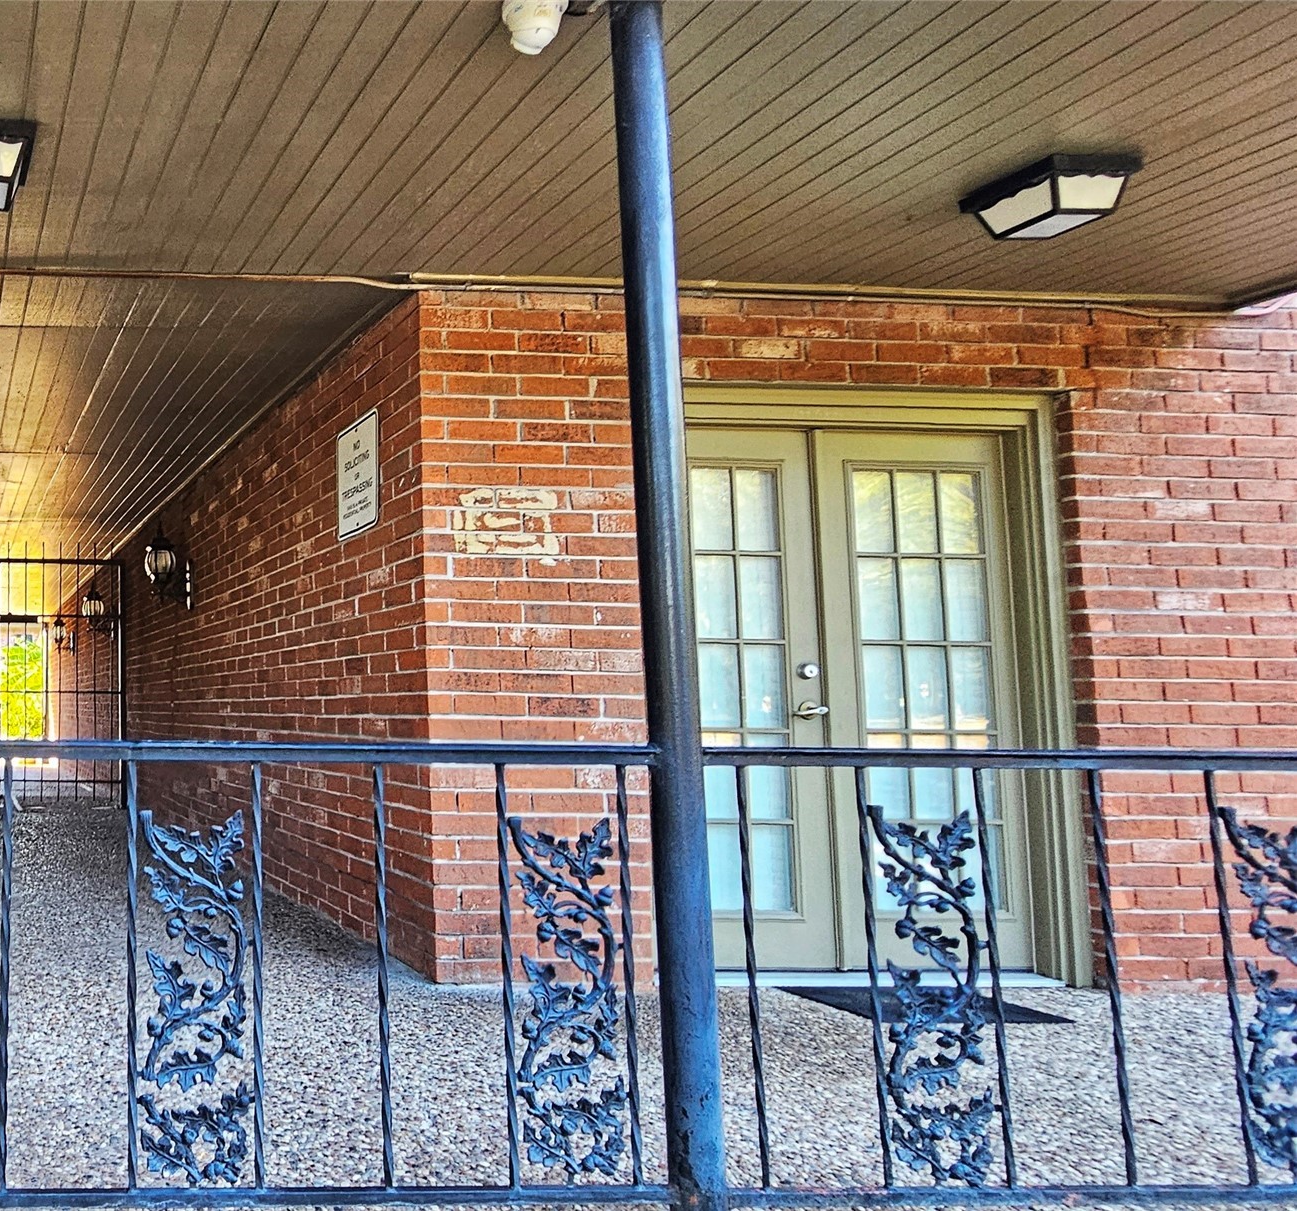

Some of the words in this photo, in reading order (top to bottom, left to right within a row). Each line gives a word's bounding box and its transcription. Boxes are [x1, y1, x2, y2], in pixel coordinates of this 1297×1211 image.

[353, 440, 360, 450] NO
[344, 449, 369, 472] SOLICITING
[342, 477, 372, 500] TRESPASSING
